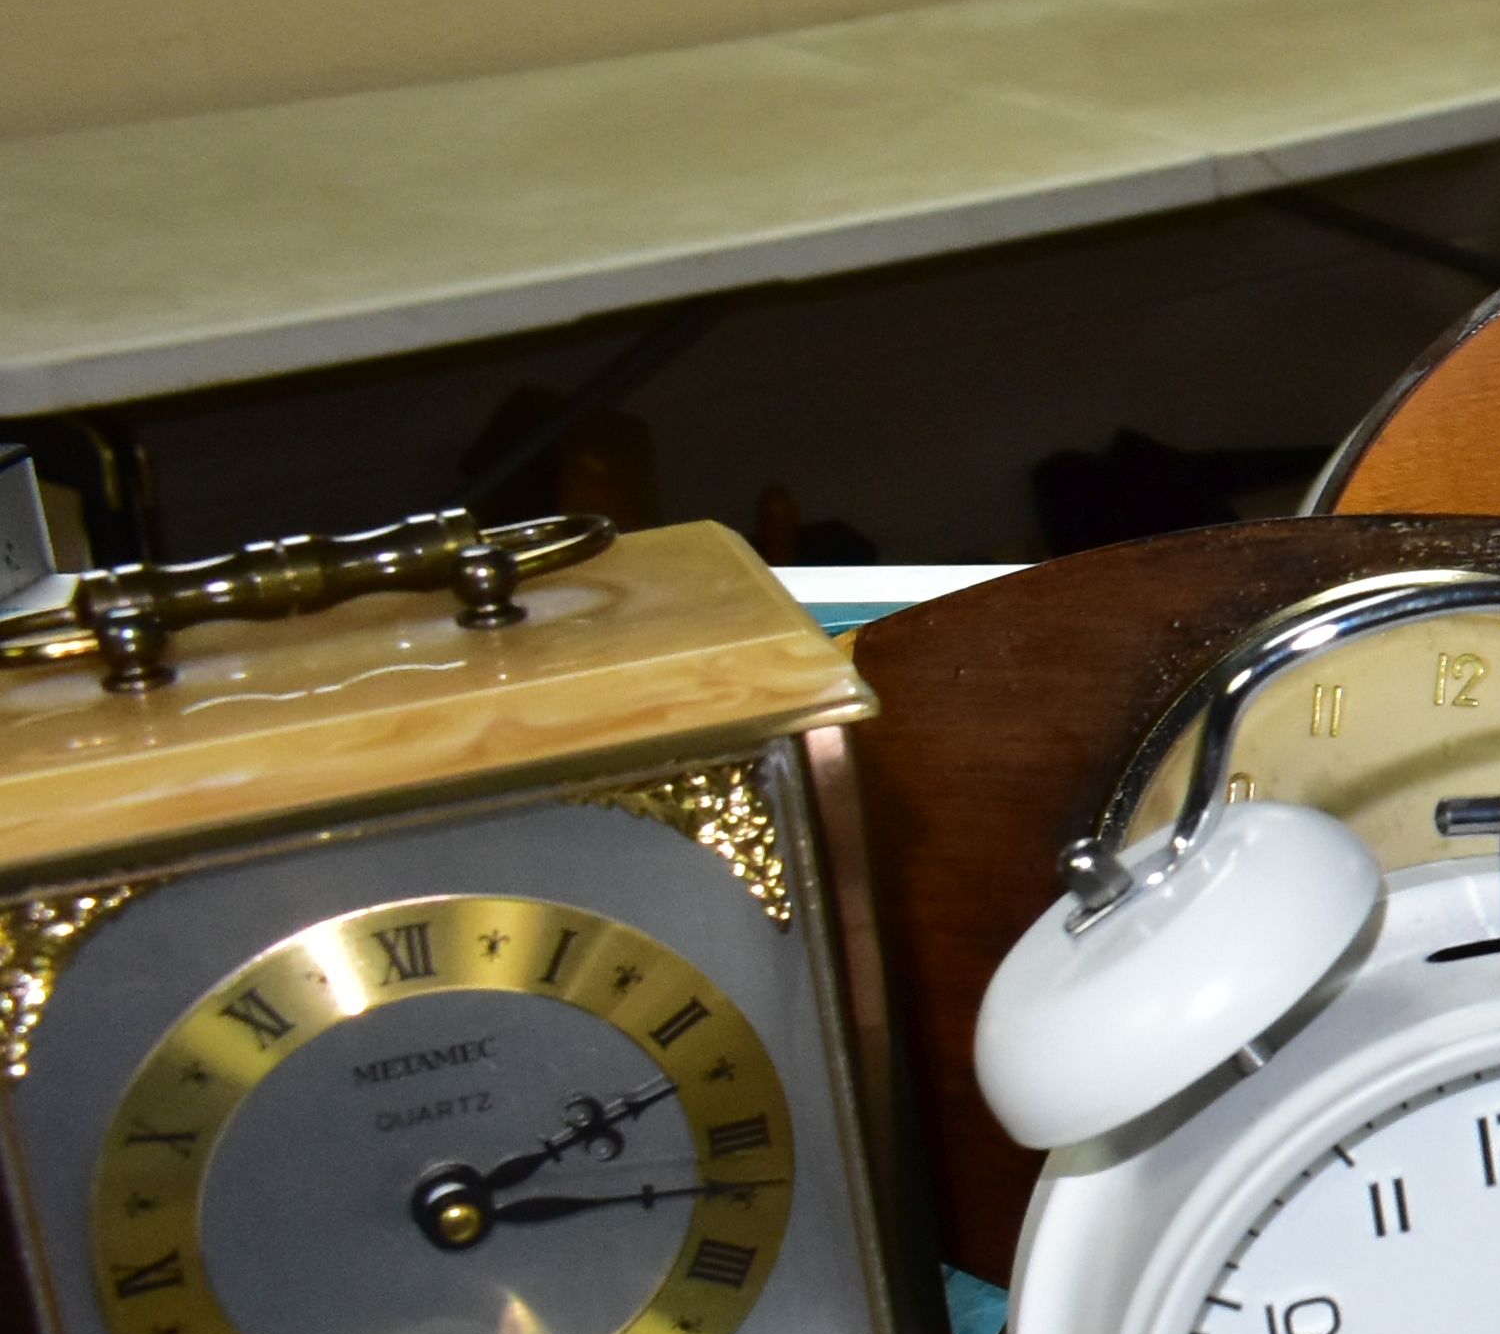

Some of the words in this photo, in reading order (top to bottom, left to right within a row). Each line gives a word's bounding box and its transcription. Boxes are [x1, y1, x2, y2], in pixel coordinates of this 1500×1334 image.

[1434, 651, 1486, 707] 12
[1310, 682, 1343, 737] 11
[371, 921, 435, 986] XII
[539, 927, 577, 985] I
[219, 987, 297, 1052] XI
[648, 996, 711, 1050] II
[352, 1035, 498, 1088] METAMEC
[125, 1115, 199, 1157] X
[375, 1091, 494, 1133] QUARTZ
[707, 1113, 772, 1159] III
[1368, 1177, 1411, 1238] 11
[114, 1249, 186, 1300] IX
[686, 1238, 757, 1289] IIII
